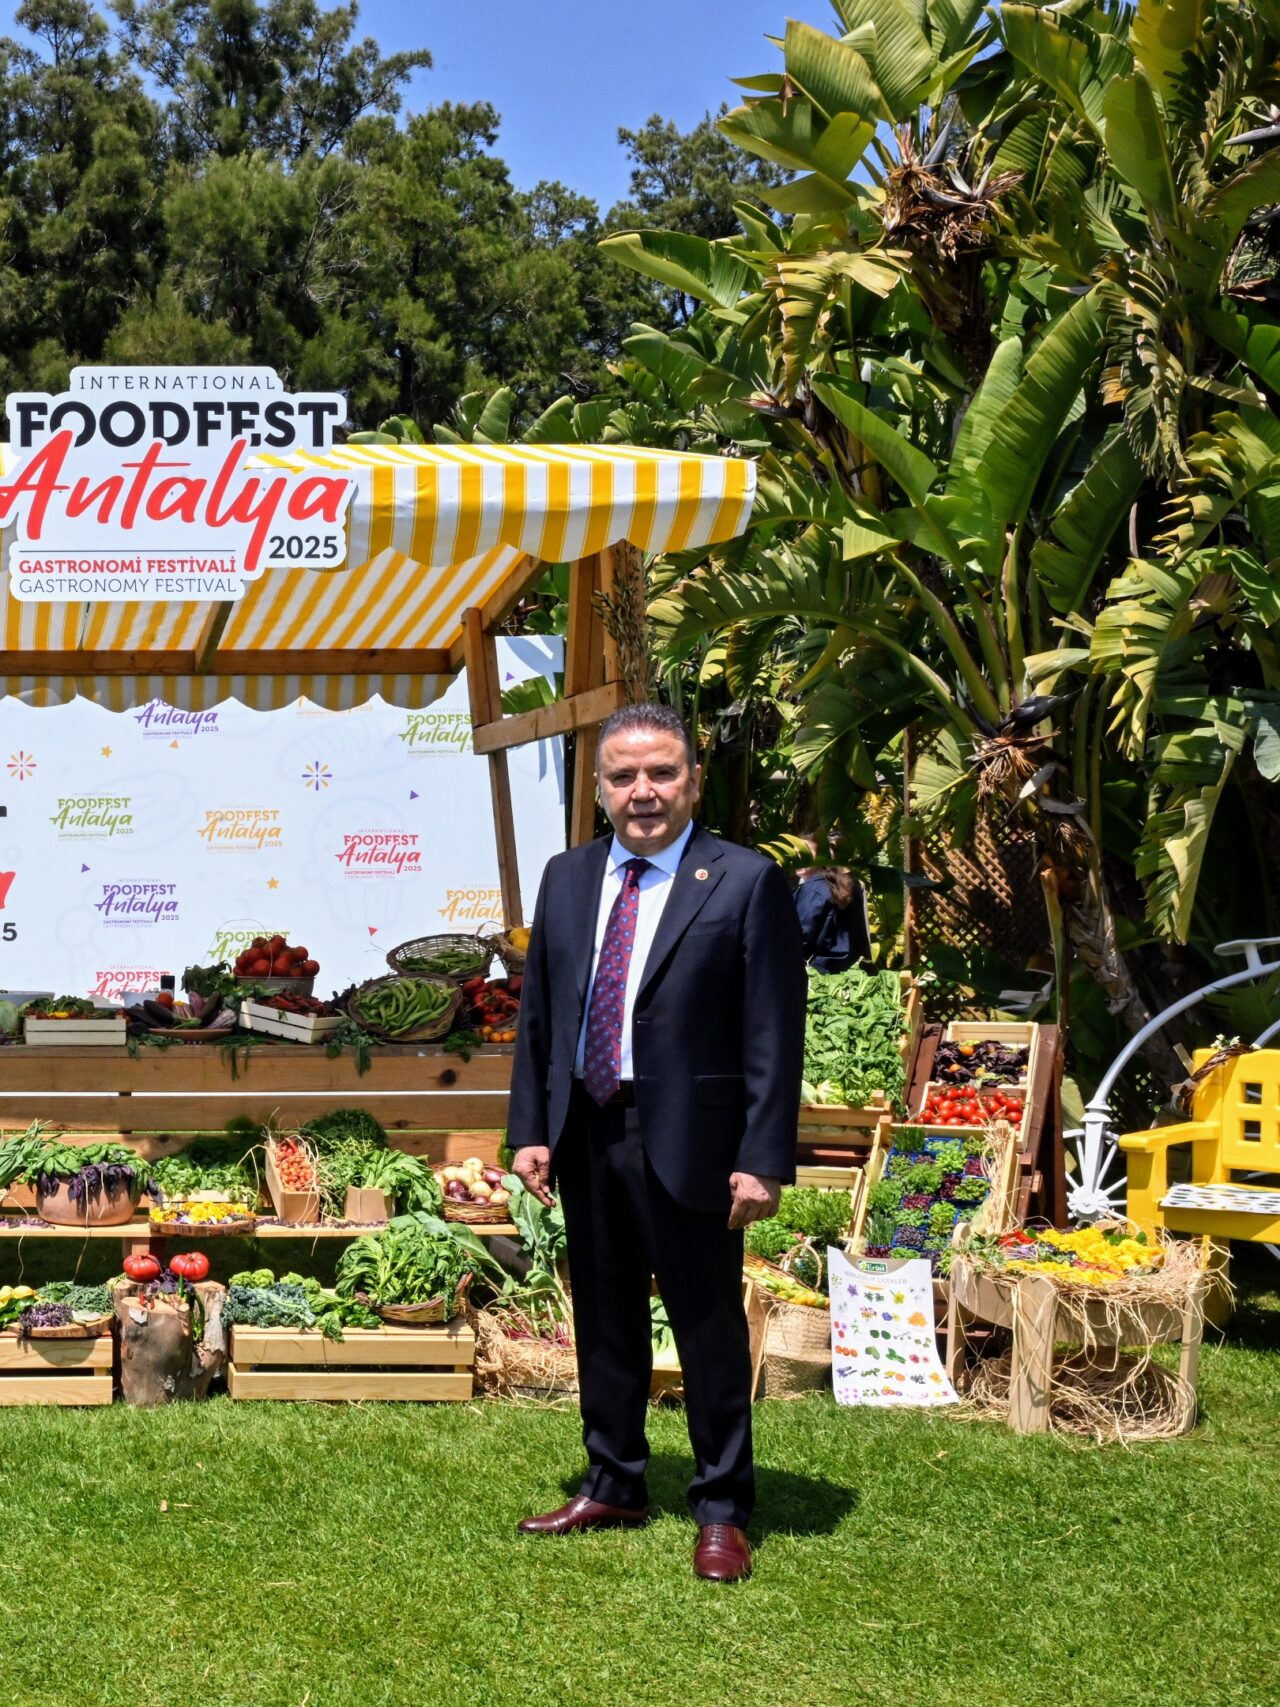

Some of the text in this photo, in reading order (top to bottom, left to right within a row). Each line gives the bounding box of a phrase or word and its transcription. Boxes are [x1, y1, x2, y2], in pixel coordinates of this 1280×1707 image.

[79, 375, 276, 391] INTERNATIONAL
[16, 400, 339, 448] FOODFEST
[269, 535, 339, 560] 2025
[19, 555, 237, 574] GASTRONOMİ FESTİVALİ
[19, 578, 237, 594] GASTRONOMY FESTIVAL
[406, 714, 472, 725] FOODFES
[398, 721, 472, 753] Antaly
[57, 797, 131, 809] FOODFEST
[48, 805, 133, 837] Antalya
[205, 810, 280, 821] FOODFEST
[196, 817, 282, 849] Antalya
[344, 834, 419, 846] FOODFEST
[334, 841, 421, 874] Antalya
[102, 884, 176, 895] FOODFEST
[93, 891, 179, 923] Antalya
